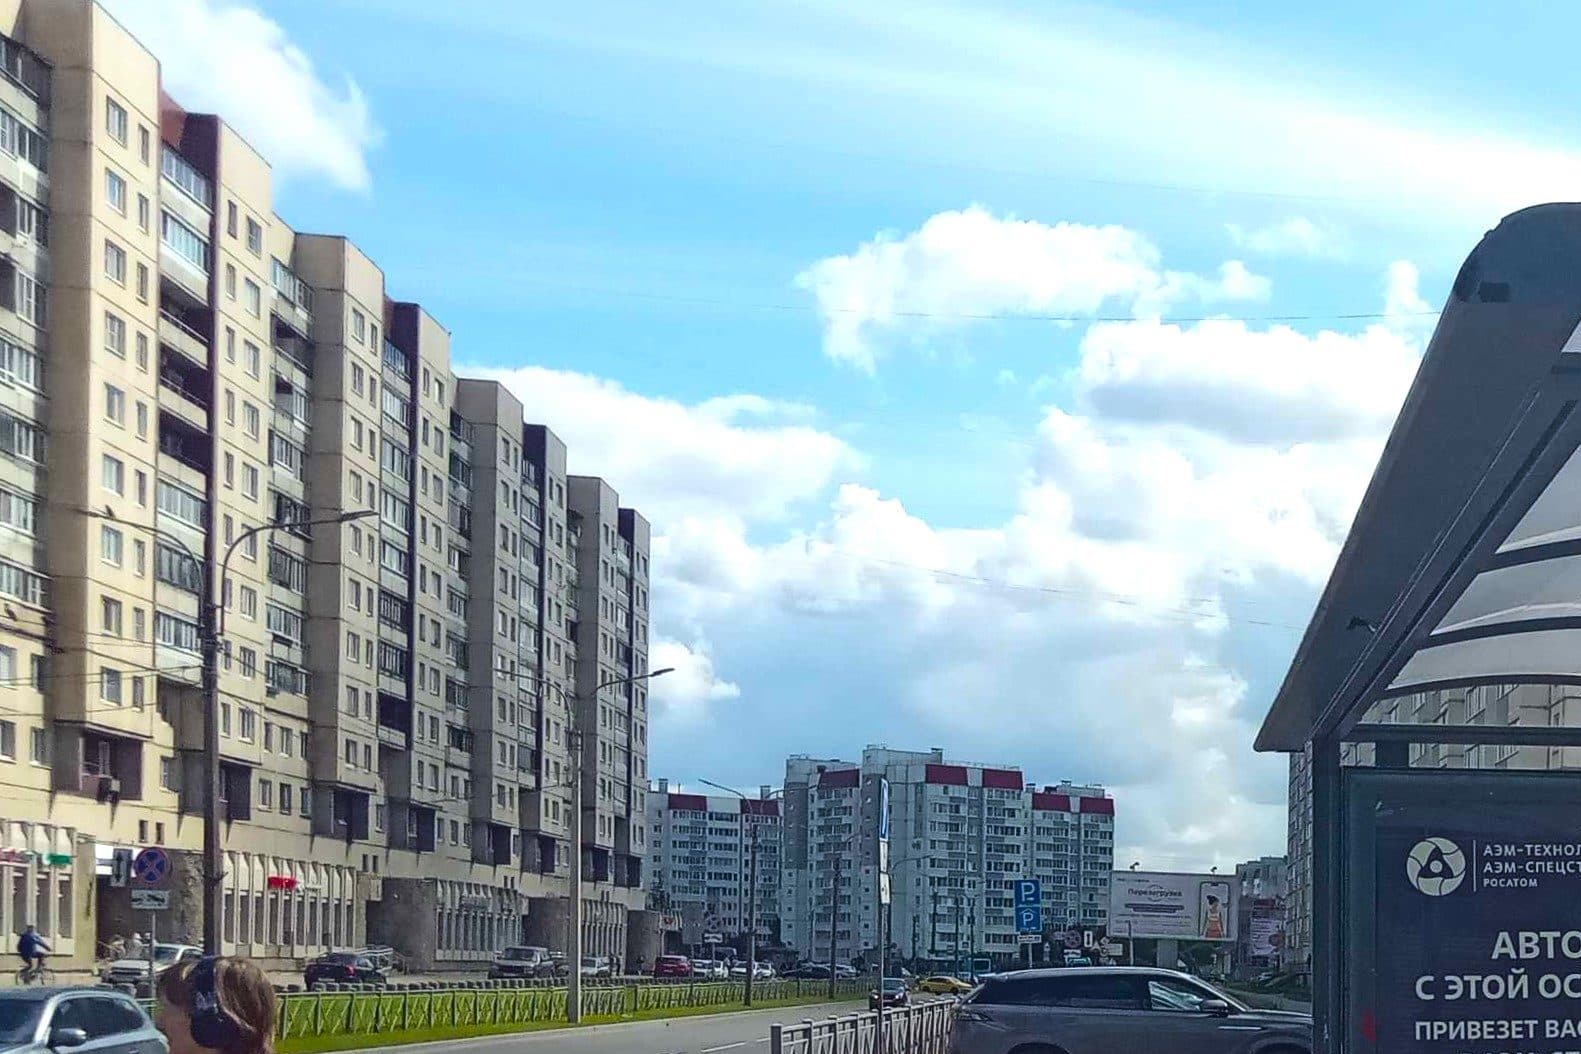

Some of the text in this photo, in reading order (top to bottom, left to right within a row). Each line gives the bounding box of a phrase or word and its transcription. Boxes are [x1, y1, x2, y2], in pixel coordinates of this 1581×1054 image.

[1484, 878, 1537, 887] РОСАТОМ
[1416, 976, 1434, 1000] С
[1445, 968, 1528, 999] ЭТОЙ
[1416, 1020, 1538, 1040] ПРИВЕЗЕТ
